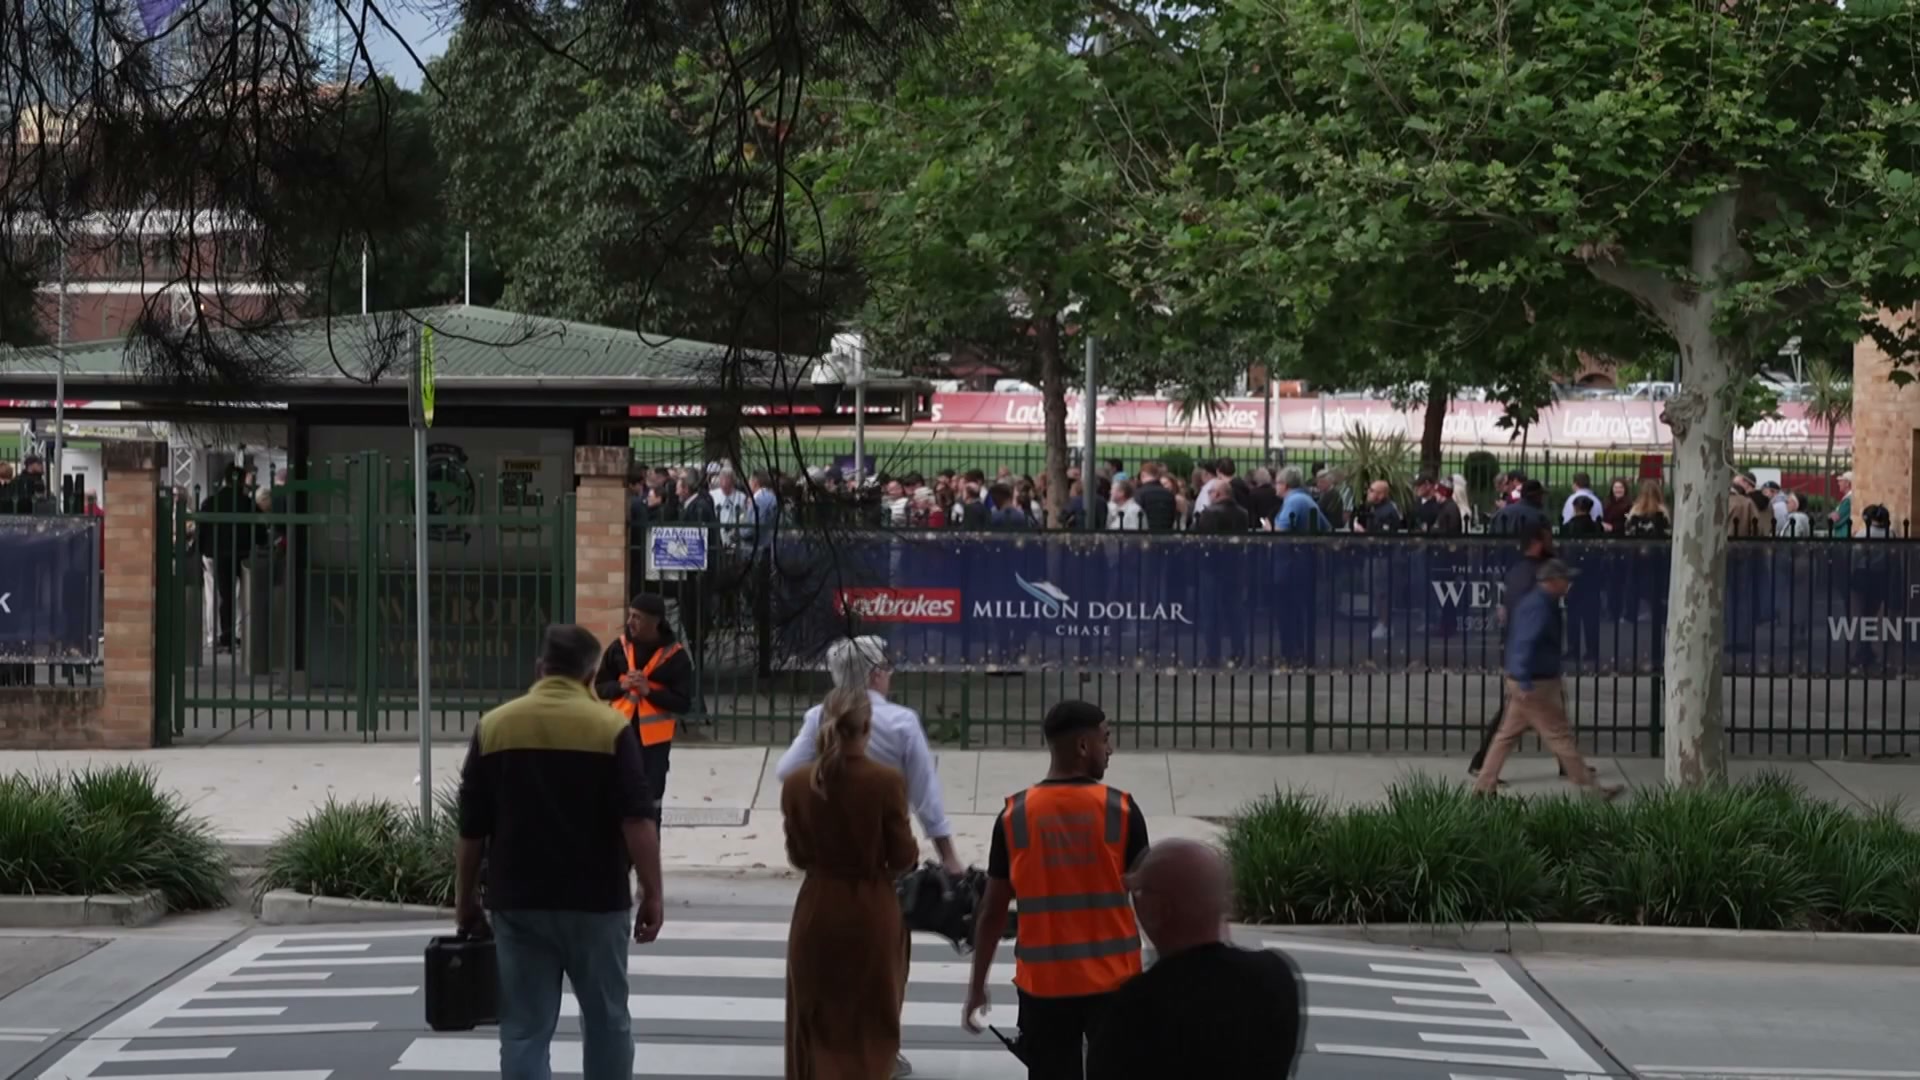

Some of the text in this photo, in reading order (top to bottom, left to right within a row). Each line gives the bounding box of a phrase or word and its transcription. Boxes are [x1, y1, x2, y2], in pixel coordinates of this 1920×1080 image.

[1563, 409, 1652, 438] Ladbrokes
[1452, 565, 1507, 574] THE LAST
[839, 590, 955, 617] Ladbrokes
[973, 599, 1193, 624] MILLION DOLLAR
[1056, 625, 1111, 637] CHASE
[1828, 616, 1920, 642] WENT
